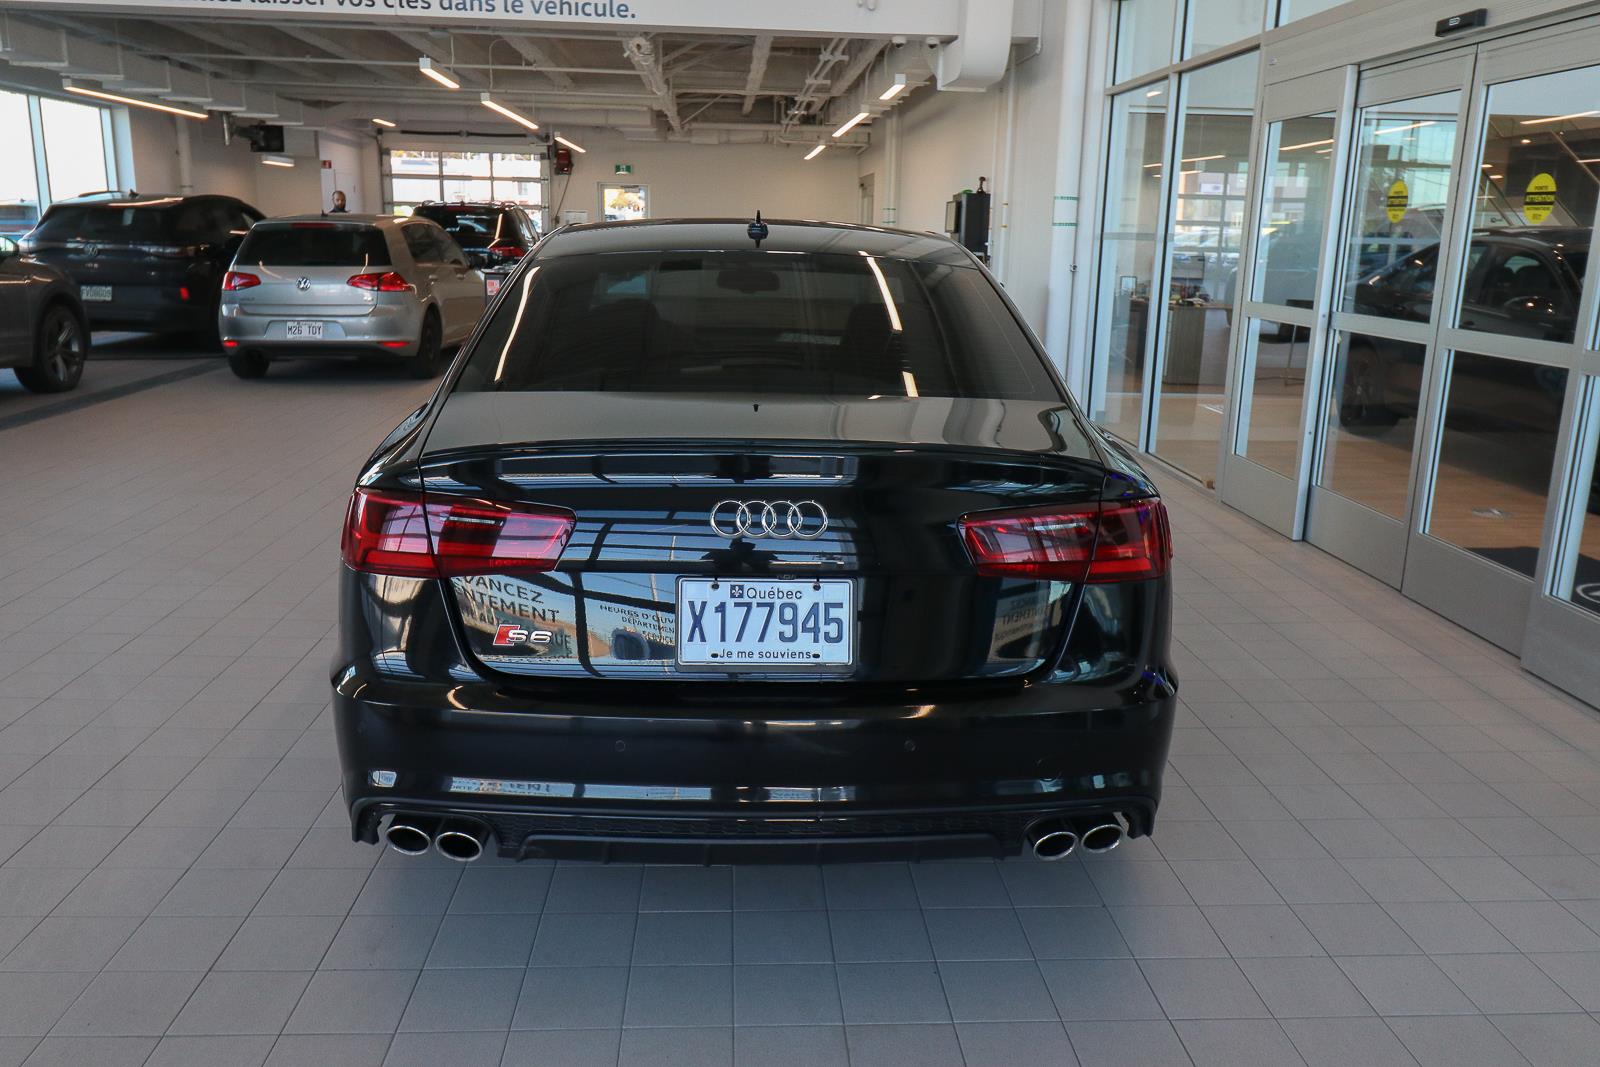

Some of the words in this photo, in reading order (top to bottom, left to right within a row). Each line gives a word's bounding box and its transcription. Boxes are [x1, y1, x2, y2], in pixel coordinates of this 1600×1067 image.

[503, 0, 524, 14] le
[746, 586, 803, 600] Québec
[600, 604, 639, 618] HEURES
[642, 612, 675, 624] D'OUV
[687, 600, 844, 644] X177945
[506, 629, 553, 644] S6
[719, 649, 733, 659] Je
[737, 651, 754, 659] me
[758, 649, 811, 659] souviens
